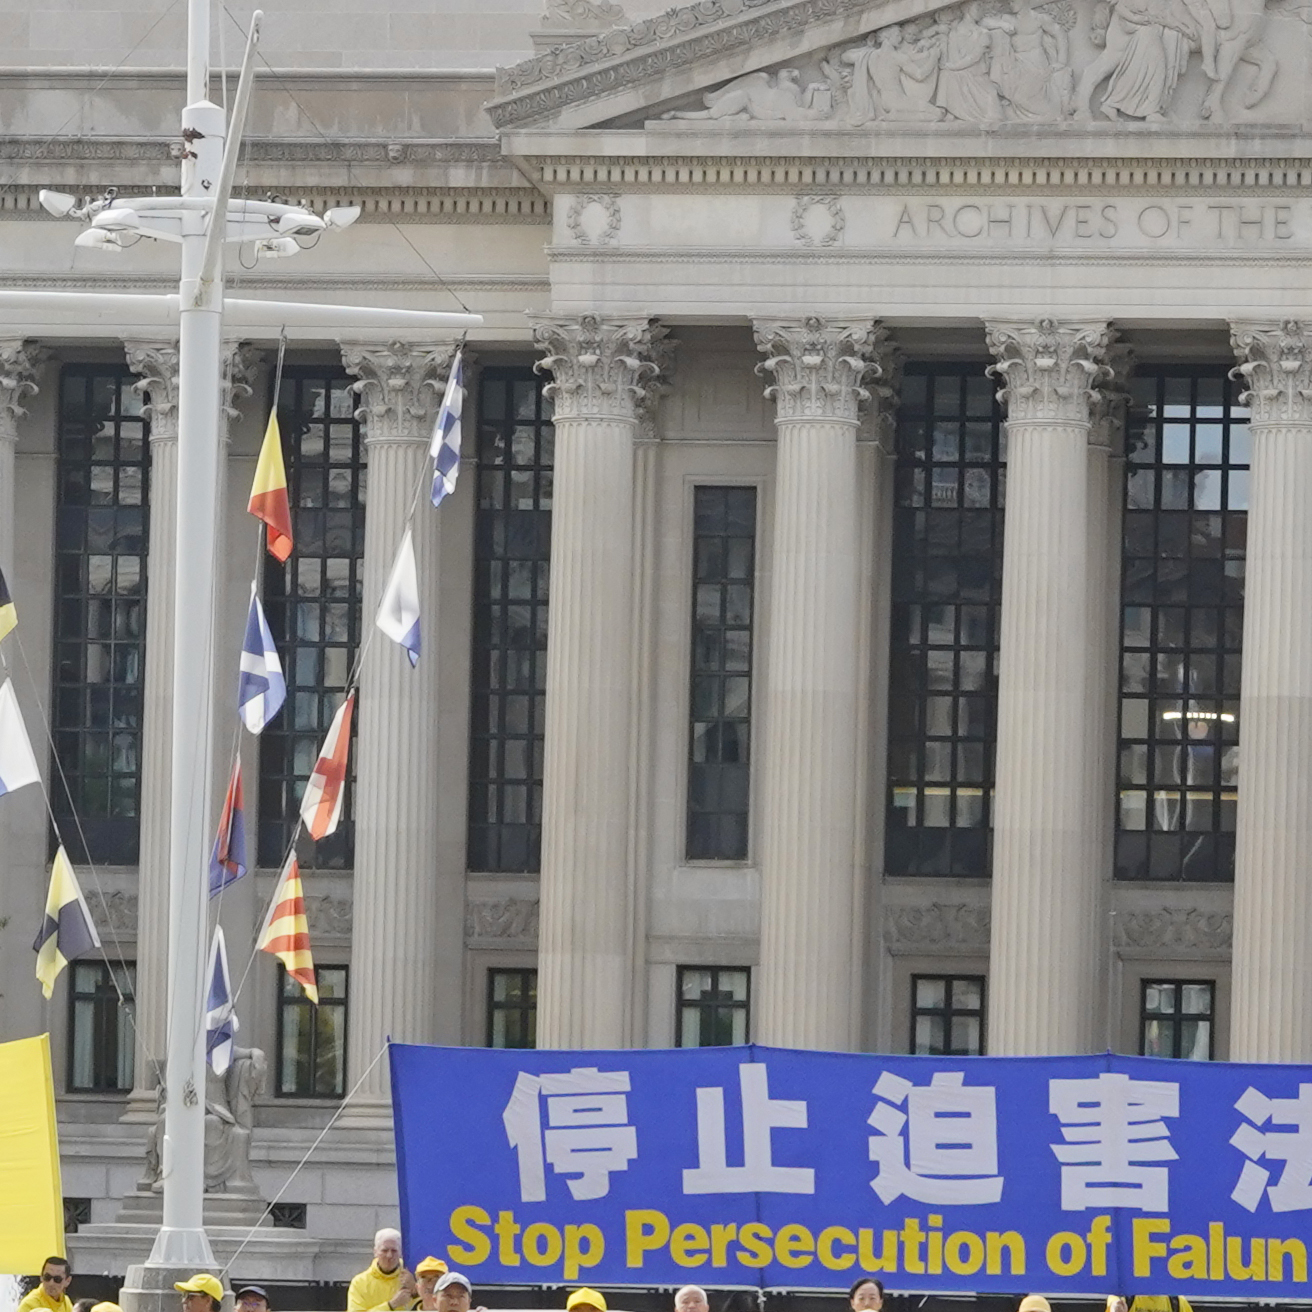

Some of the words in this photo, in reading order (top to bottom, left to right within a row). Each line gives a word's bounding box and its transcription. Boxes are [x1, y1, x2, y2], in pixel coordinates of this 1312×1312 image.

[893, 204, 1119, 241] ARCHIVES
[1137, 204, 1192, 241] OF
[1207, 204, 1292, 241] THE
[446, 1204, 606, 1281] Stop
[624, 1208, 1027, 1277] Persecution
[1045, 1214, 1113, 1277] of
[1132, 1217, 1308, 1283] Falun
